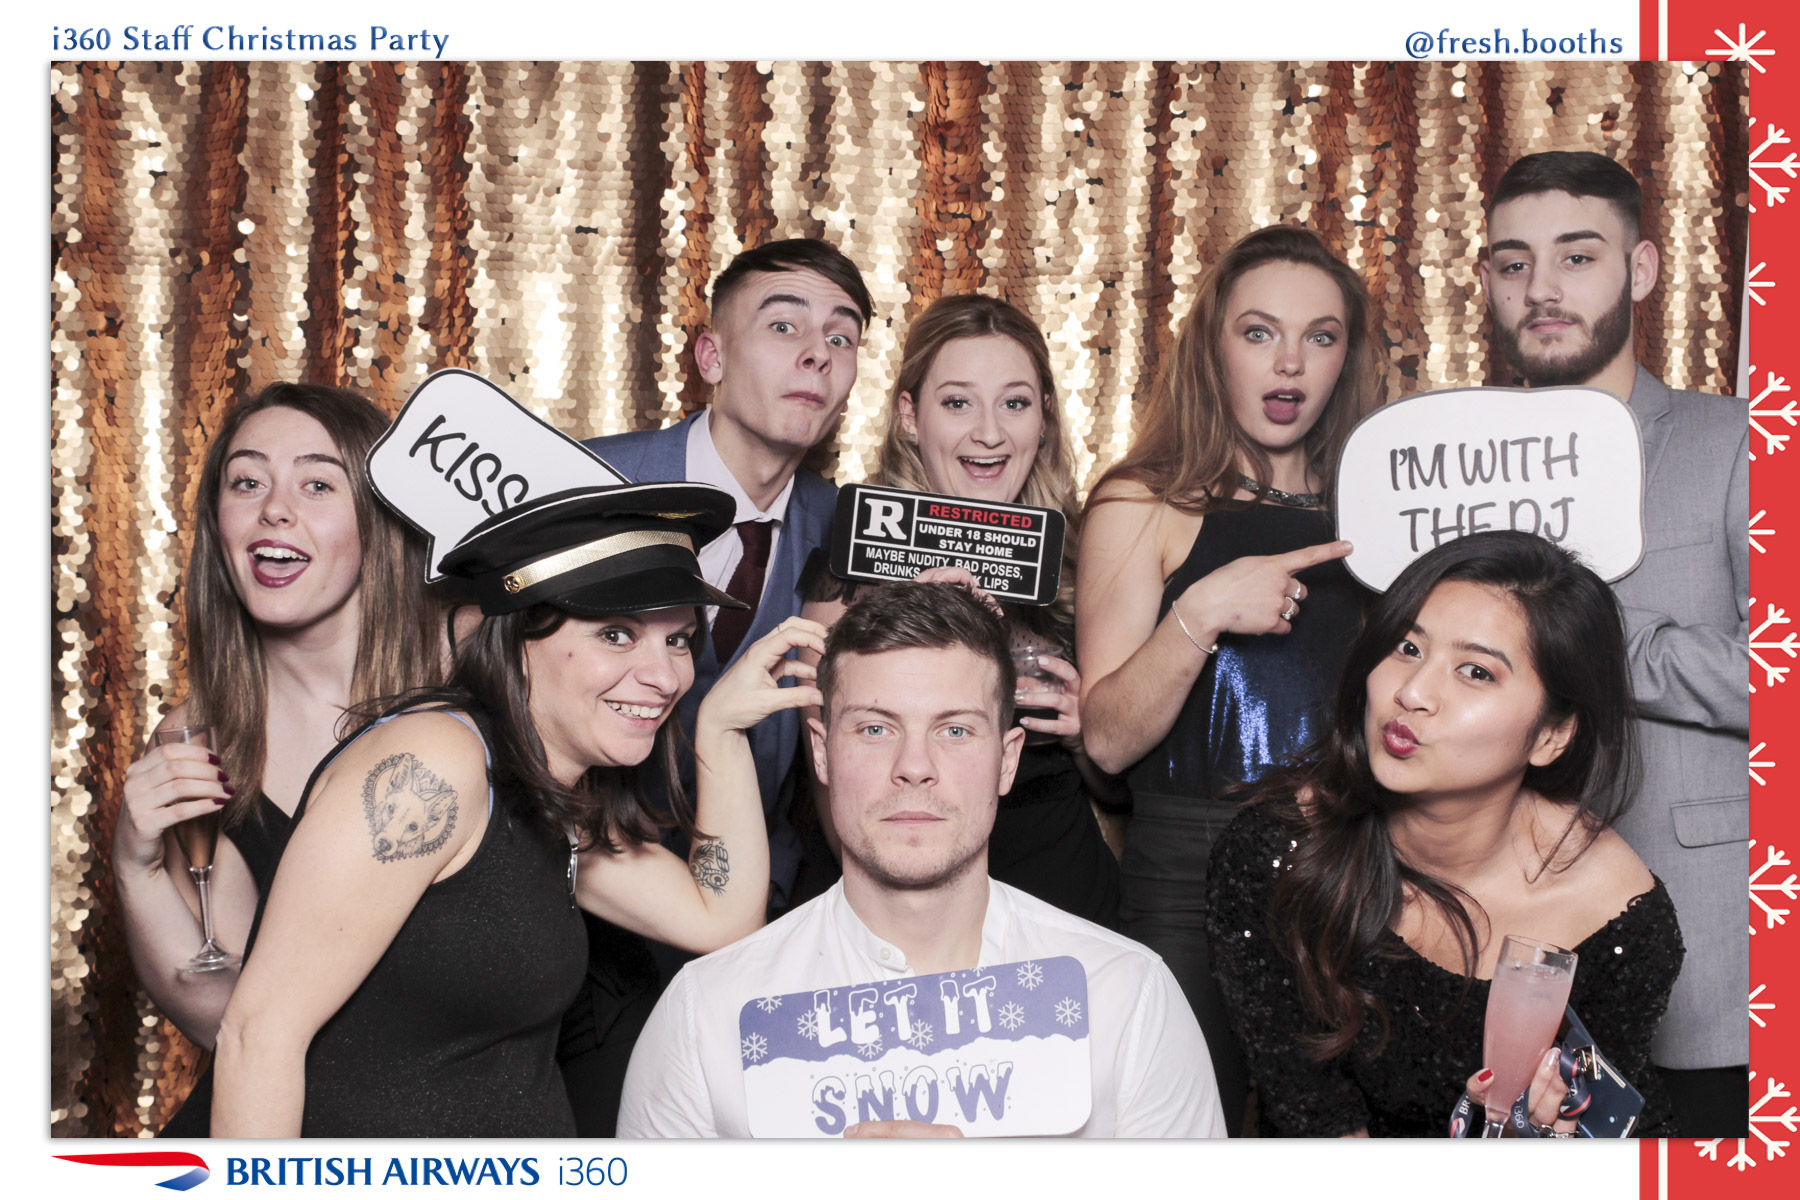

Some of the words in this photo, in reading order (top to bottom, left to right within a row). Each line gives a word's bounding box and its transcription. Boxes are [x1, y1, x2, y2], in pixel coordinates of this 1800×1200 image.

[408, 414, 529, 517] KISS
[1390, 442, 1448, 491] I'M
[1458, 431, 1579, 487] WITH
[862, 498, 907, 540] R
[919, 523, 962, 539] UNDER
[966, 529, 981, 541] 18
[984, 531, 1037, 548] SHOULD
[929, 504, 1032, 529] RESTRICTED
[1399, 501, 1497, 552] THE
[1509, 497, 1575, 543] DJ
[866, 546, 905, 563] MAYBE
[955, 558, 980, 573] BAD
[981, 562, 1023, 580] POSES,
[939, 539, 973, 552] STAY
[975, 544, 1013, 558] HOME
[984, 577, 1009, 591] LIPS
[813, 983, 918, 1048] LET
[940, 975, 997, 1035] IT
[812, 1061, 1014, 1135] SNOW
[1458, 1095, 1471, 1115] BR
